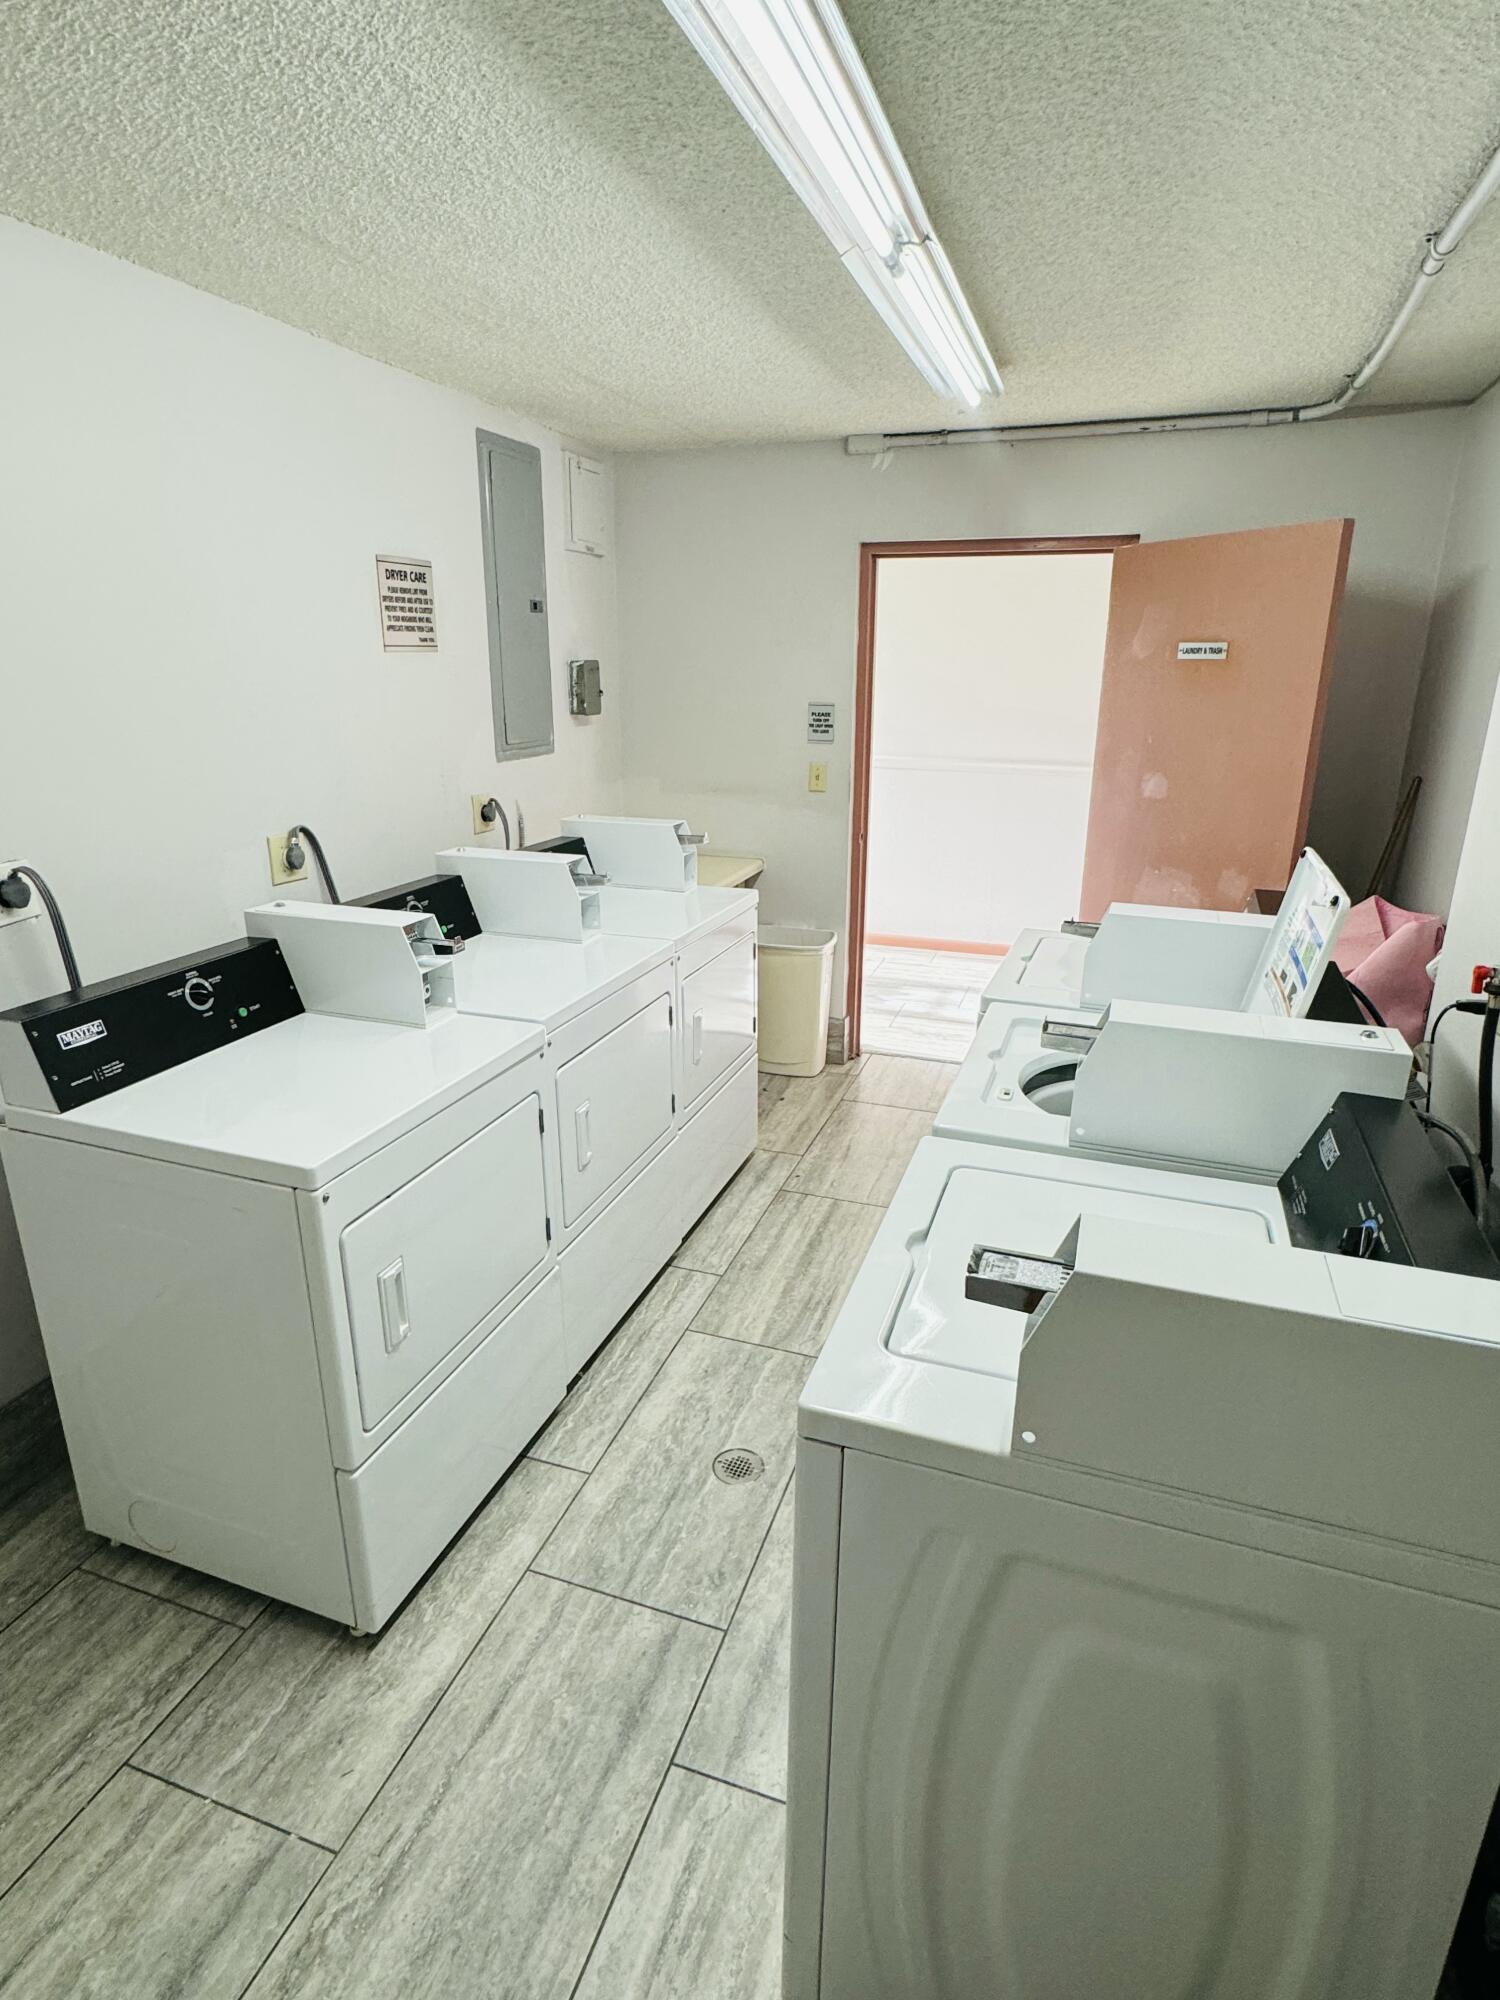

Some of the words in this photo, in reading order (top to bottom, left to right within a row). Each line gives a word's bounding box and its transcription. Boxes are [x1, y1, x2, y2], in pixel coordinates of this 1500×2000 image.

[385, 568, 408, 582] DRYER
[410, 571, 427, 584] CARE
[61, 1022, 103, 1044] MAYTAG
